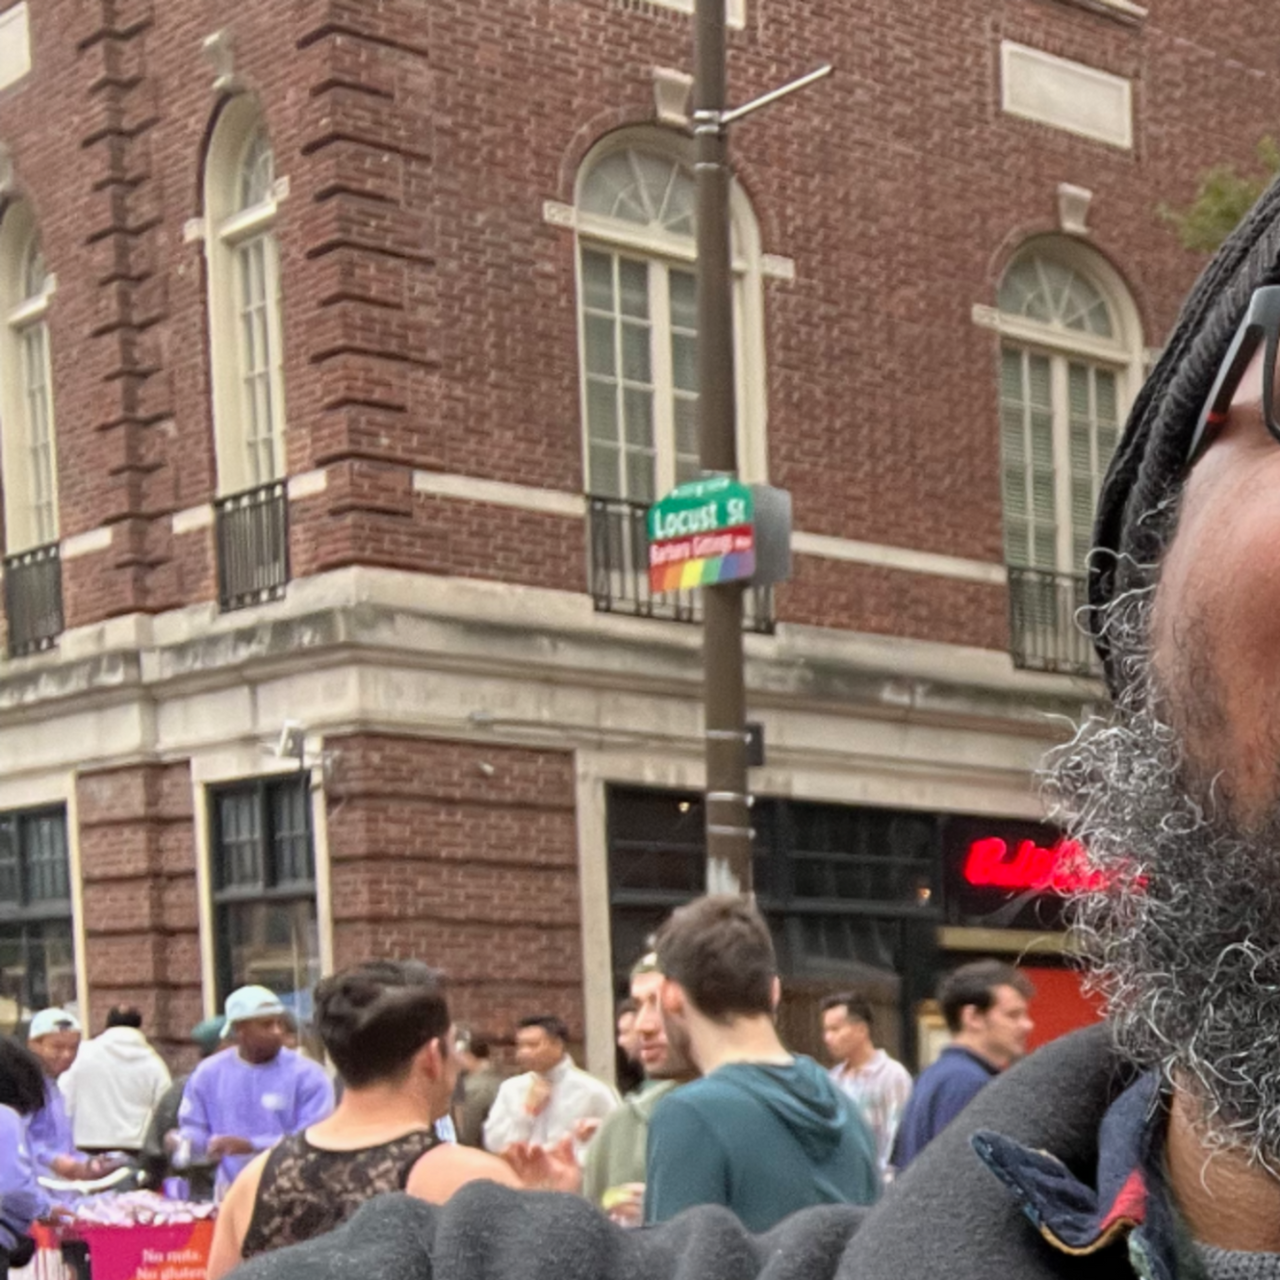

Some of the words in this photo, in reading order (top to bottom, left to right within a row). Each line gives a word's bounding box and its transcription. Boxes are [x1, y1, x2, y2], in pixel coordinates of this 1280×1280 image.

[654, 501, 718, 540] Locust
[143, 1249, 163, 1262] No
[136, 1267, 158, 1280] No
